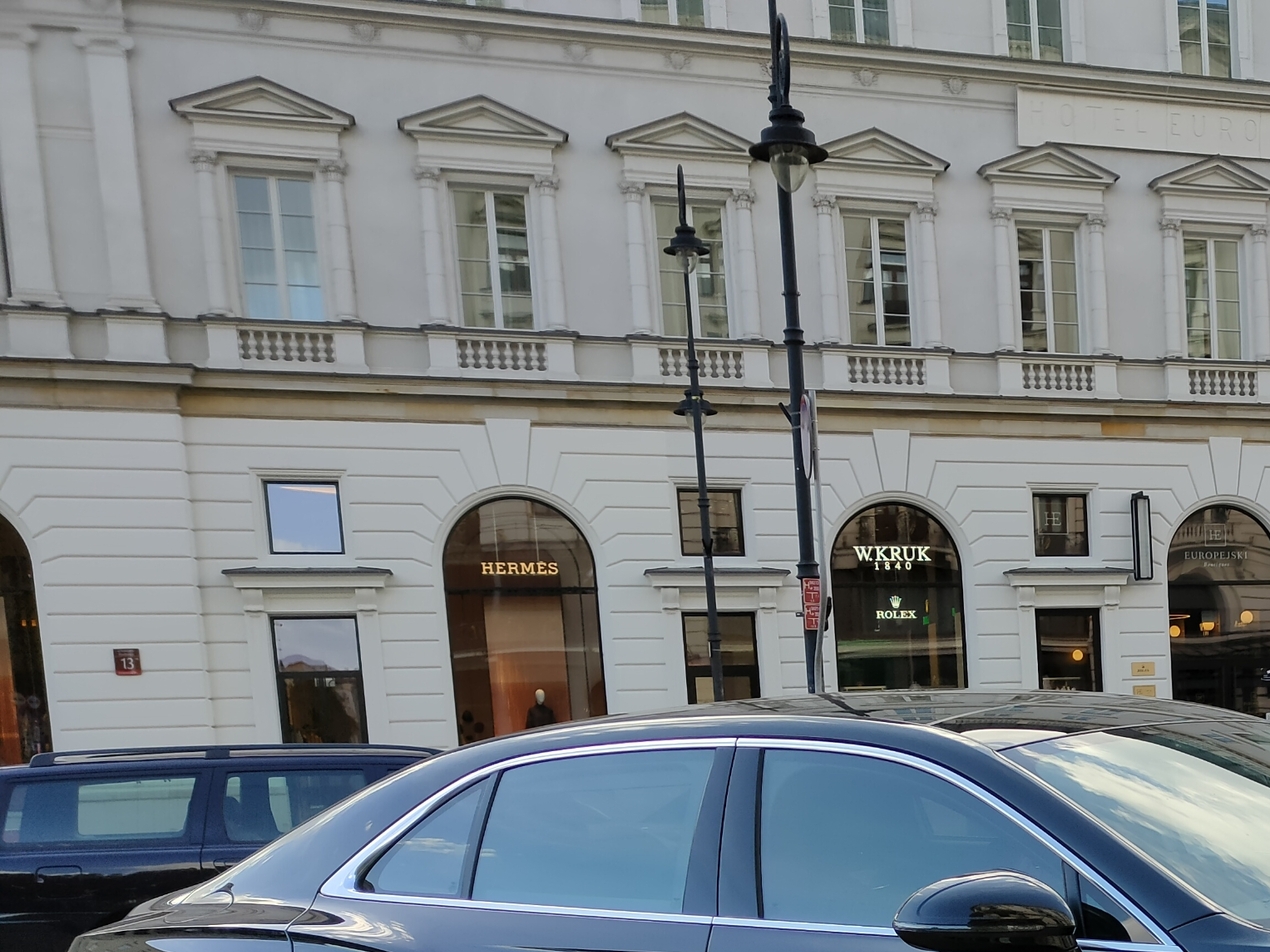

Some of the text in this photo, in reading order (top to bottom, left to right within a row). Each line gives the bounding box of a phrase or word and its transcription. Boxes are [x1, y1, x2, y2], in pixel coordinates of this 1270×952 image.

[1029, 99, 1148, 134] HOTEL
[852, 545, 932, 562] W.KRUK
[1184, 551, 1249, 560] EUROPEJSKI
[874, 561, 912, 571] 1840
[876, 610, 918, 619] ROLEX
[120, 657, 135, 670] 13
